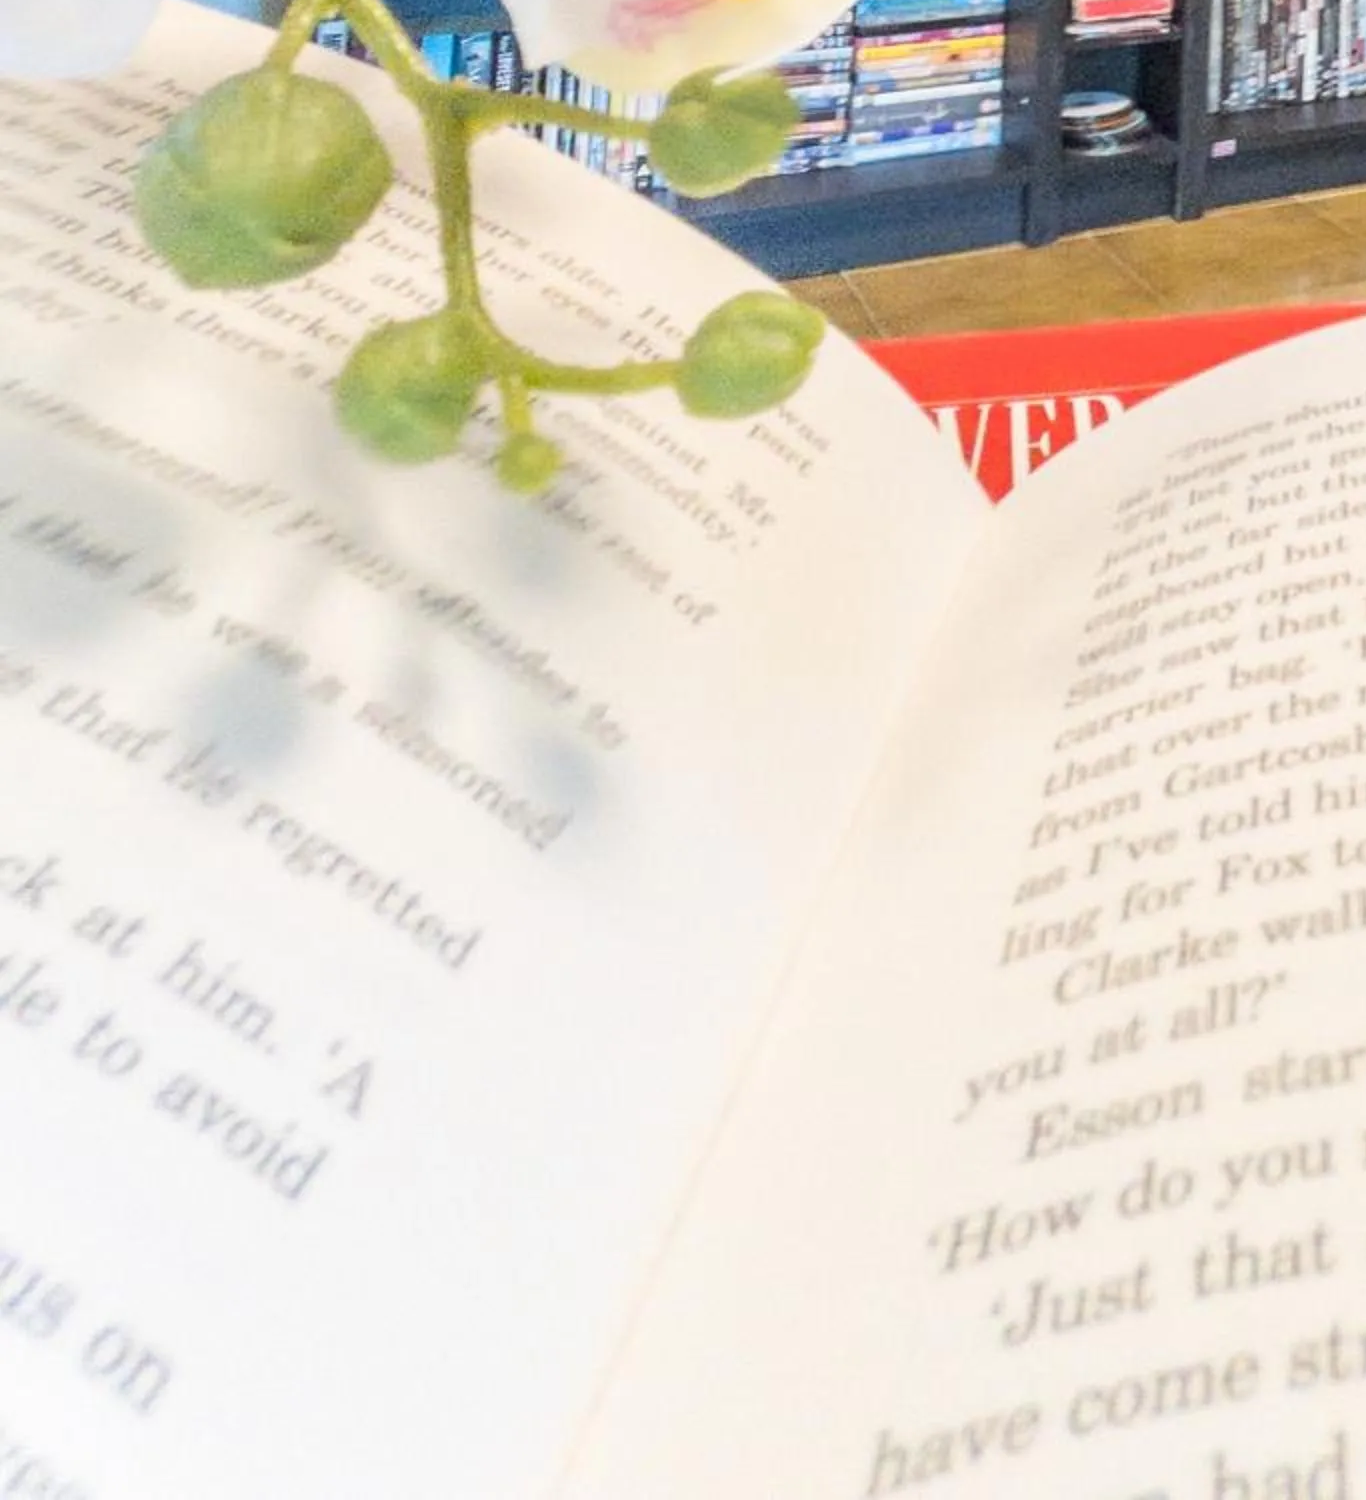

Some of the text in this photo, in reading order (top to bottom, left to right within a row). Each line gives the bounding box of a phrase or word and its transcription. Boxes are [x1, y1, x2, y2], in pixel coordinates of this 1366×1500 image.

[1150, 710, 1253, 757] over
[1267, 690, 1341, 726] the
[1197, 787, 1292, 843] told
[241, 798, 486, 976] regretted
[1119, 877, 1196, 924] for
[1216, 850, 1311, 897] Fox
[70, 902, 149, 963] at
[154, 935, 282, 1058] him.
[1051, 926, 1240, 1007] Clarke
[72, 1006, 333, 1206] to avoid
[952, 1045, 1066, 1126] you
[1087, 1012, 1147, 1067] at
[1022, 1079, 1205, 1164] Esson
[1116, 1157, 1195, 1221] do
[1214, 1136, 1334, 1212] you
[1192, 1221, 1335, 1300] that
[80, 1320, 177, 1422] on
[863, 1402, 1044, 1499] have
[1065, 1352, 1262, 1439] come
